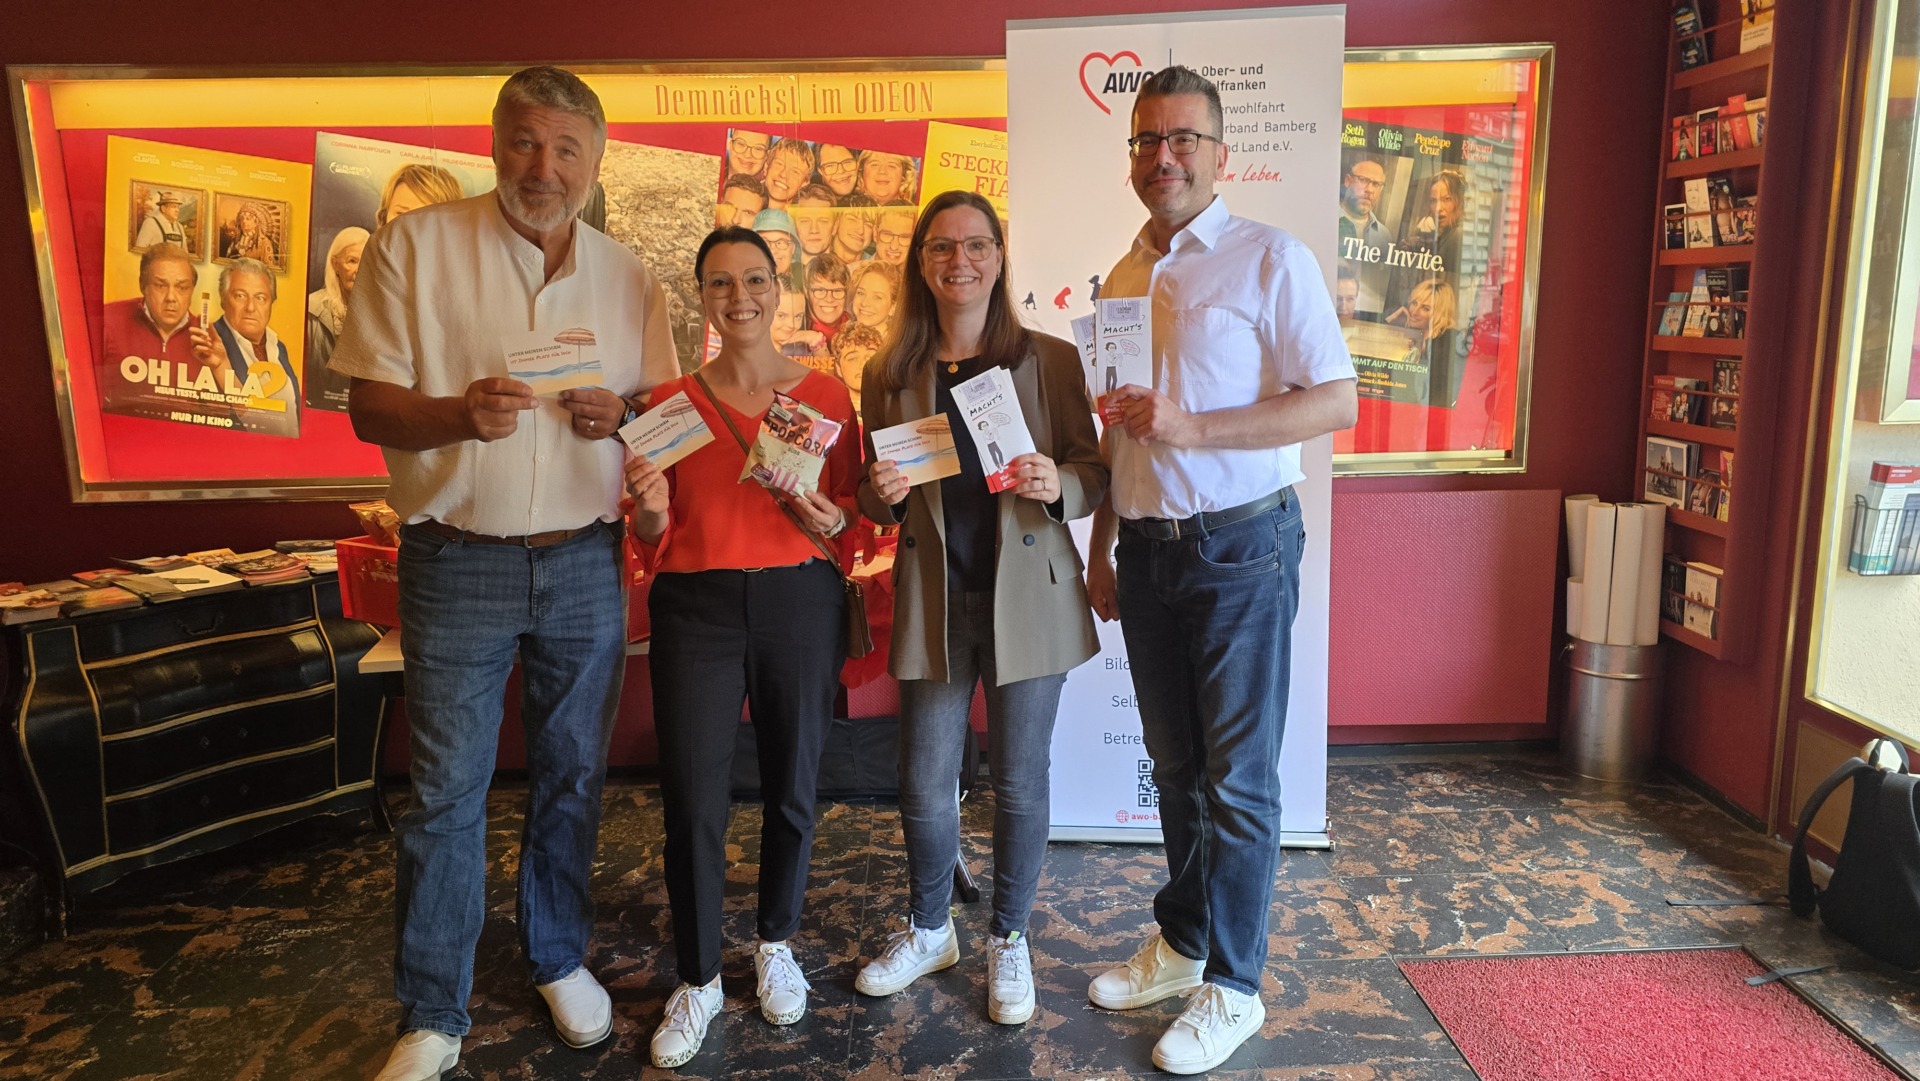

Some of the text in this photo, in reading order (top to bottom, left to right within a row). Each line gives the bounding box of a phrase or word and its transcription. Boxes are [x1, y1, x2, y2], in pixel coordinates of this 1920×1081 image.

[1201, 65, 1236, 77] Ober-
[1240, 63, 1264, 76] und
[1216, 79, 1267, 92] lfranken
[655, 81, 934, 116] Demnächst im ODEON
[1224, 121, 1317, 135] rband Bamberg
[1345, 124, 1365, 136] Seth
[1378, 128, 1403, 142] Olivia
[1228, 141, 1293, 153] nd Land e.V.
[1341, 134, 1366, 147] Rogen
[1378, 138, 1402, 151] Wilde
[1419, 145, 1441, 156] Cruz
[1242, 163, 1282, 182] Leben.
[1343, 236, 1445, 272] The Invite.
[1371, 359, 1387, 368] AUF
[1388, 362, 1404, 371] DEN
[1405, 364, 1429, 374] TISCH
[120, 355, 171, 386] OH
[177, 362, 218, 393] LA
[225, 369, 265, 398] LA
[154, 386, 176, 396] NEUE
[200, 392, 225, 402] NEUES
[225, 395, 254, 406] CHAOS
[171, 411, 233, 428] NUR IM KINO
[767, 421, 836, 460] POPCORN
[1112, 695, 1139, 708] Selb
[1131, 812, 1161, 821] awo-b
